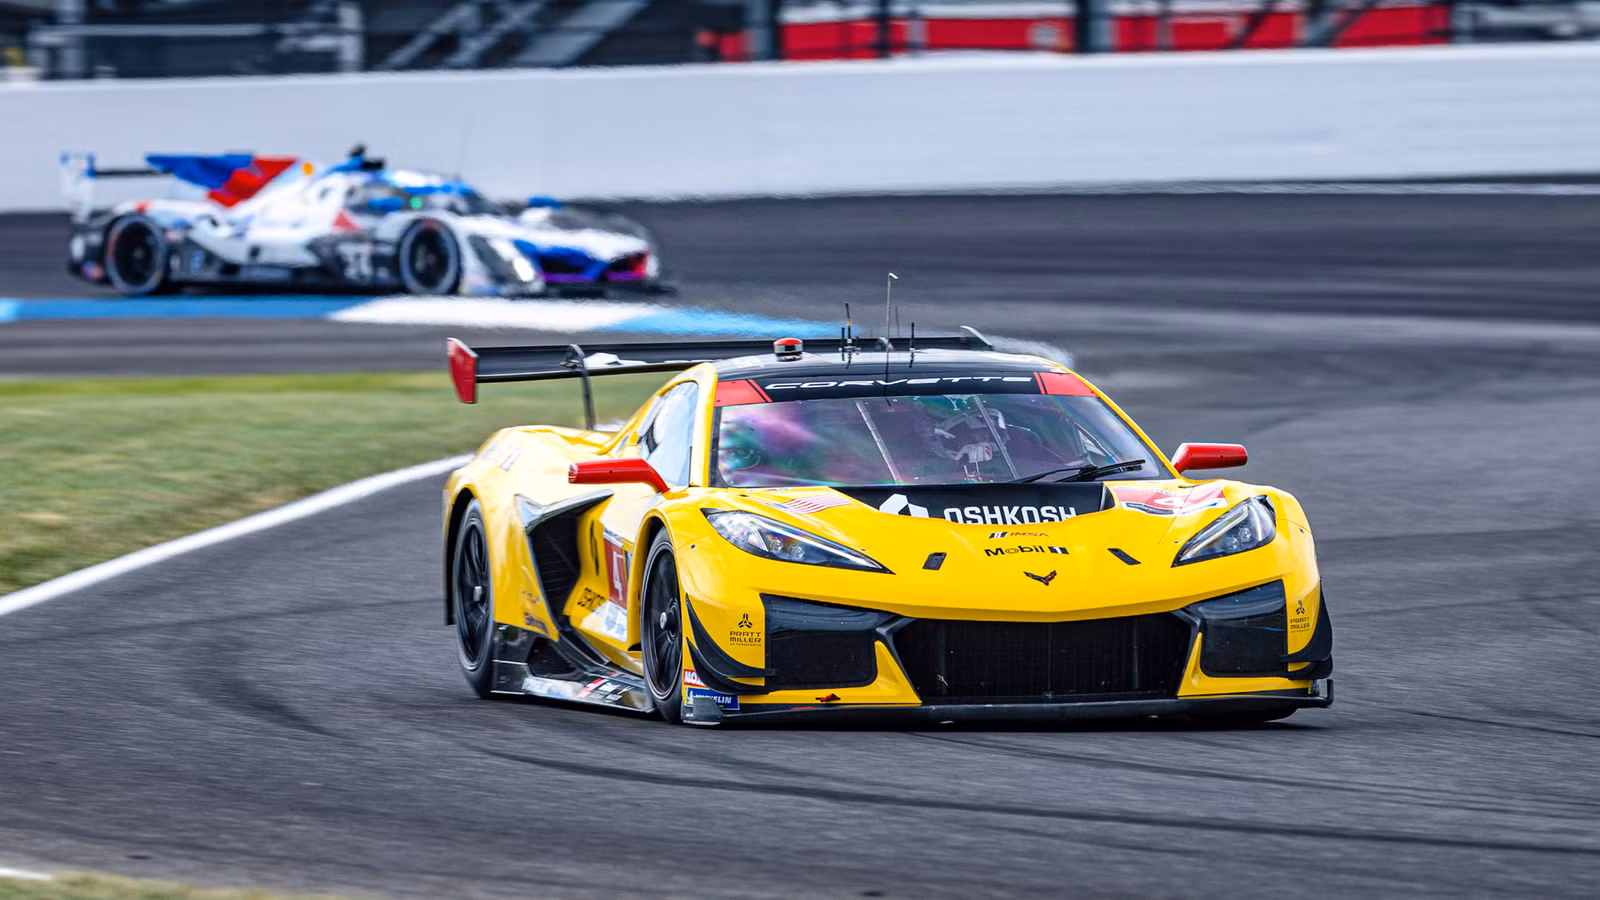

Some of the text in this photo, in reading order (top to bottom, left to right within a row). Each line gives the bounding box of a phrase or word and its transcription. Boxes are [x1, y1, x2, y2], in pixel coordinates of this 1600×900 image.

[765, 376, 1033, 390] CORVETTE
[943, 505, 1077, 525] OSHKOSH
[984, 545, 1046, 557] Mobil
[612, 551, 626, 601] 4
